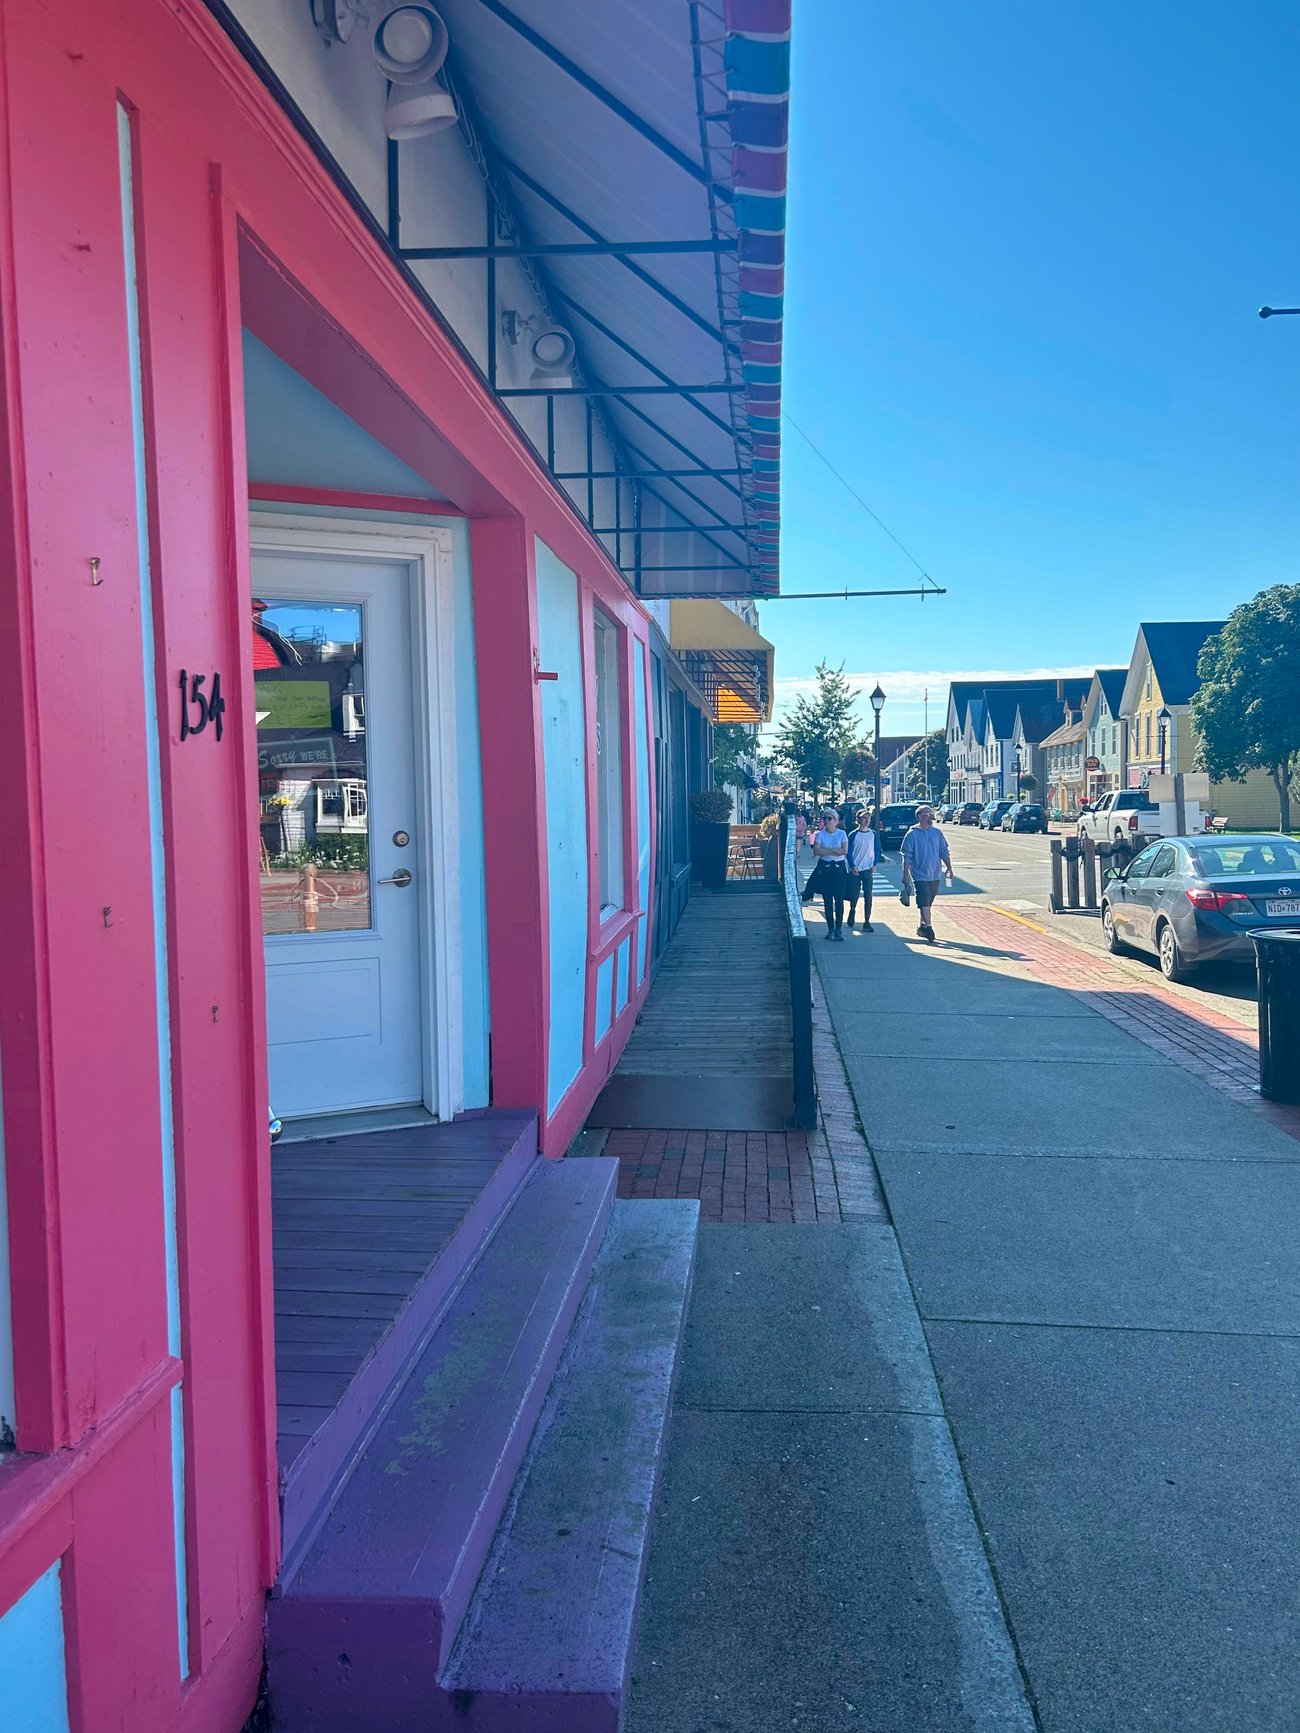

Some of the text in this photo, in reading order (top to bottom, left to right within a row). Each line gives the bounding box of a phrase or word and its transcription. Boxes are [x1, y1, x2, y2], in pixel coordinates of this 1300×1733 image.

[179, 668, 225, 742] 154
[258, 749, 328, 769] Sorry WE'RE
